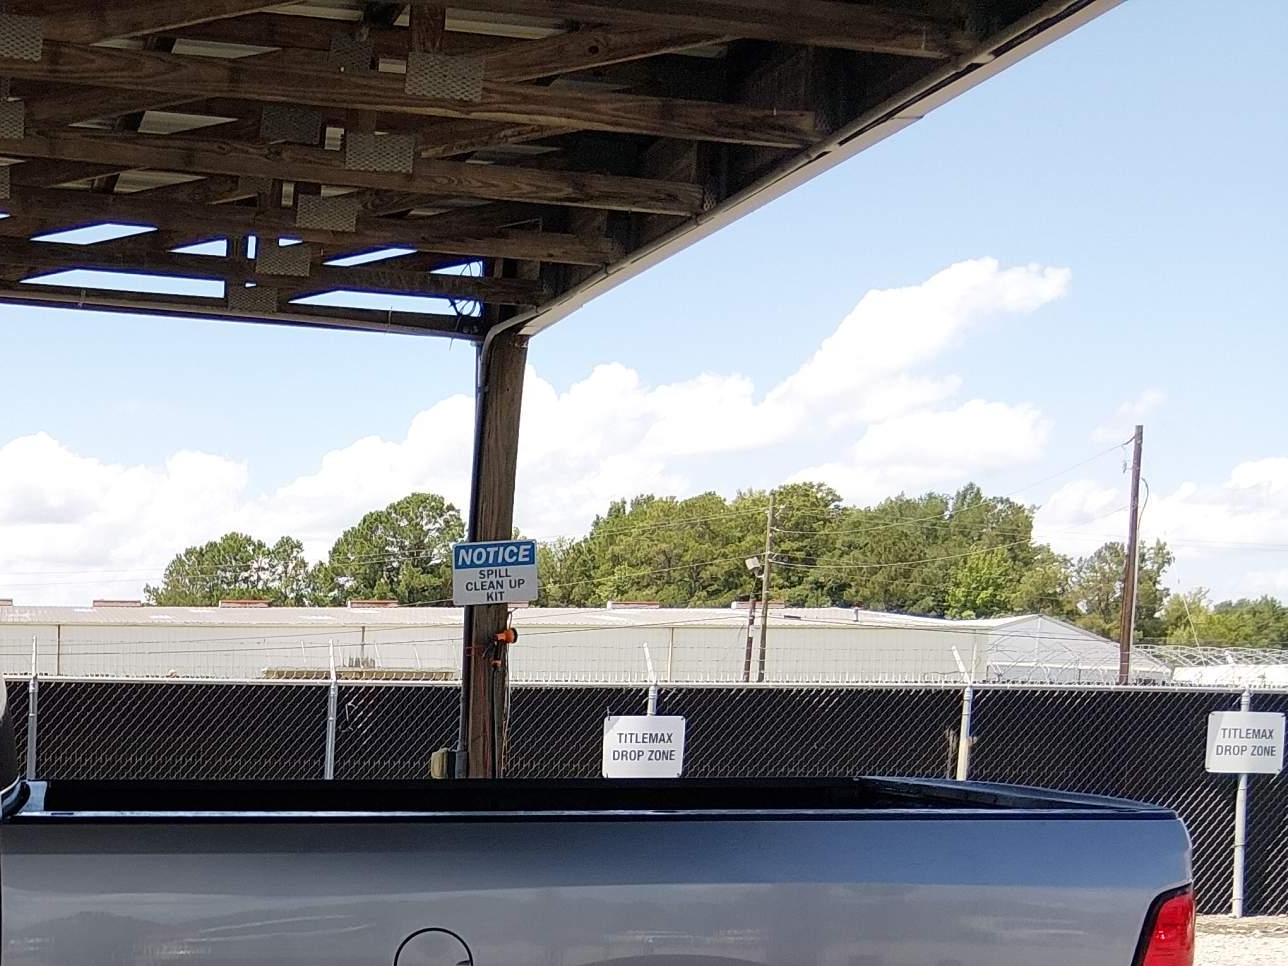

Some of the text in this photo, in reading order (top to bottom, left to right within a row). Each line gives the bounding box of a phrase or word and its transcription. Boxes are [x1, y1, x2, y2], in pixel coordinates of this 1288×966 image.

[458, 545, 531, 566] NOTICE
[479, 568, 512, 580] SPILL
[465, 579, 525, 592] CLEAN UP
[486, 591, 505, 602] KIT
[617, 732, 674, 744] TITLEMAX
[1221, 727, 1275, 740] TITLEMAX
[612, 749, 677, 761] DROP ZONE
[1215, 744, 1277, 757] DROP ZONE
